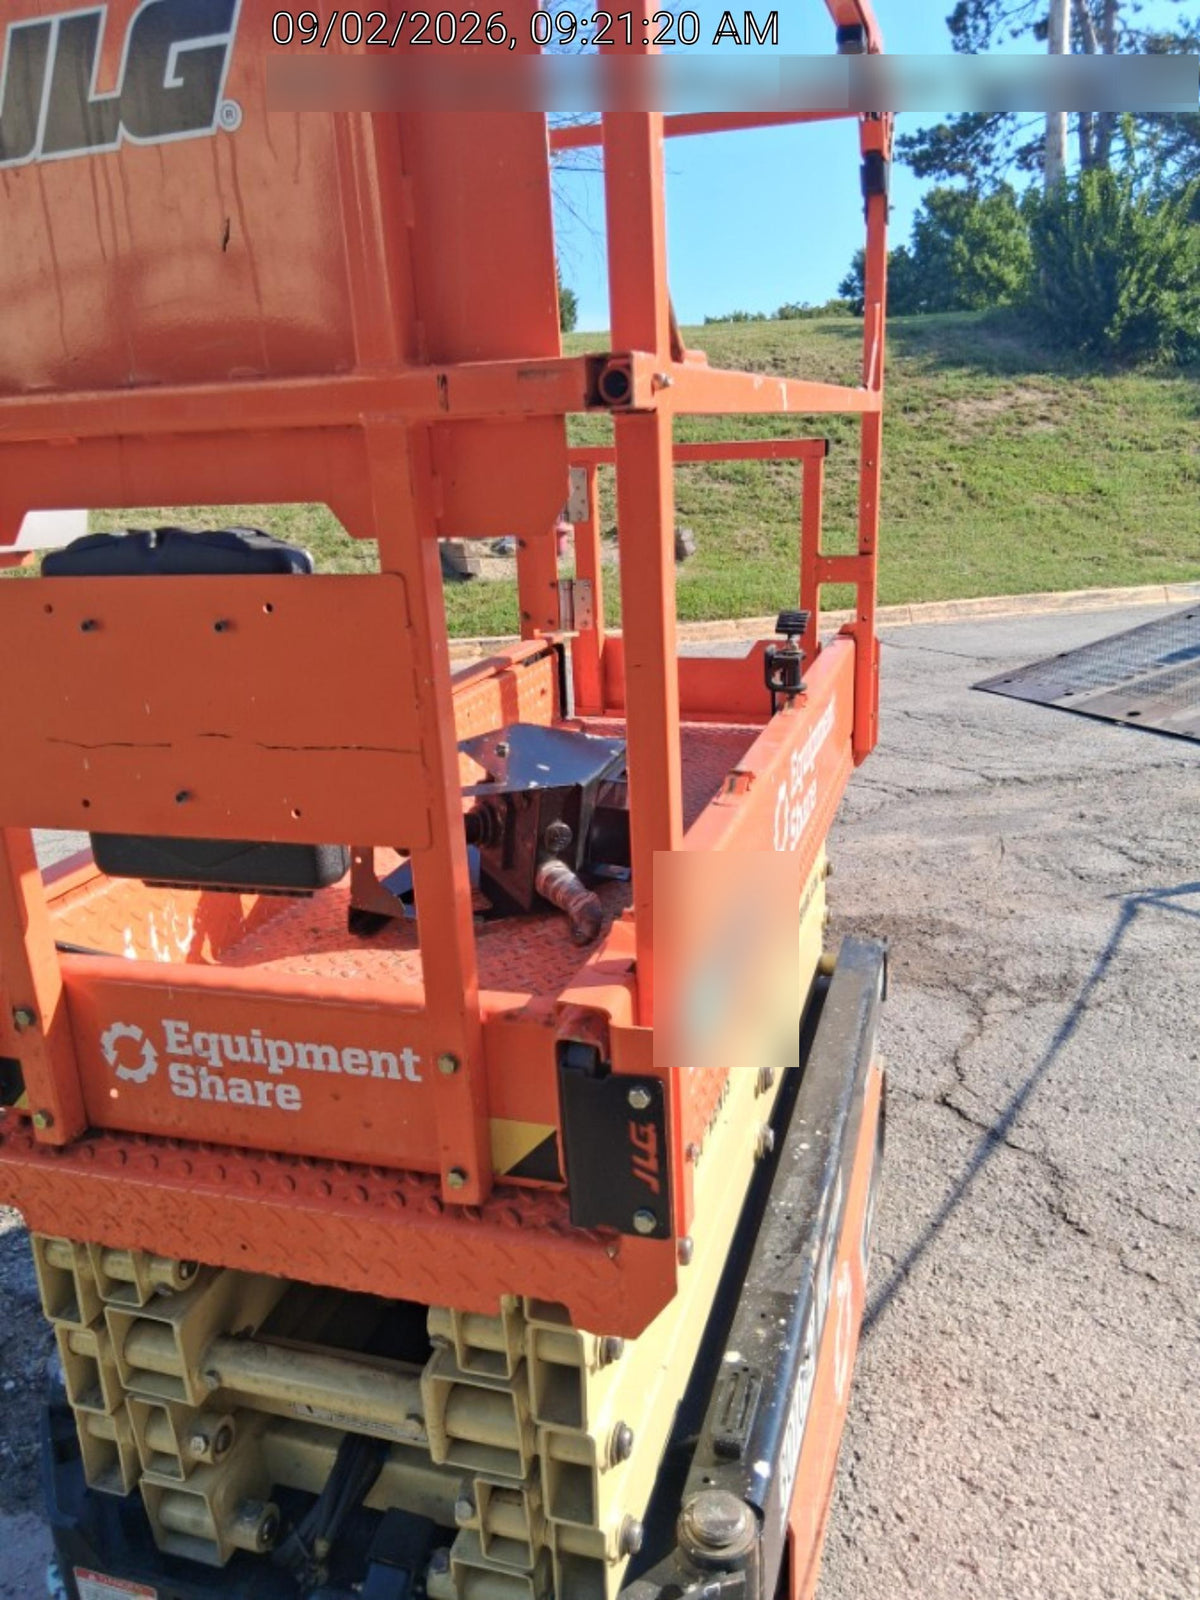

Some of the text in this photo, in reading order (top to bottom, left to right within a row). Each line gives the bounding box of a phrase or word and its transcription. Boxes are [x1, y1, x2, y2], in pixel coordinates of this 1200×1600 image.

[161, 1019, 423, 1082] Equipment
[168, 1061, 303, 1111] Share
[628, 1119, 660, 1195] JLG
